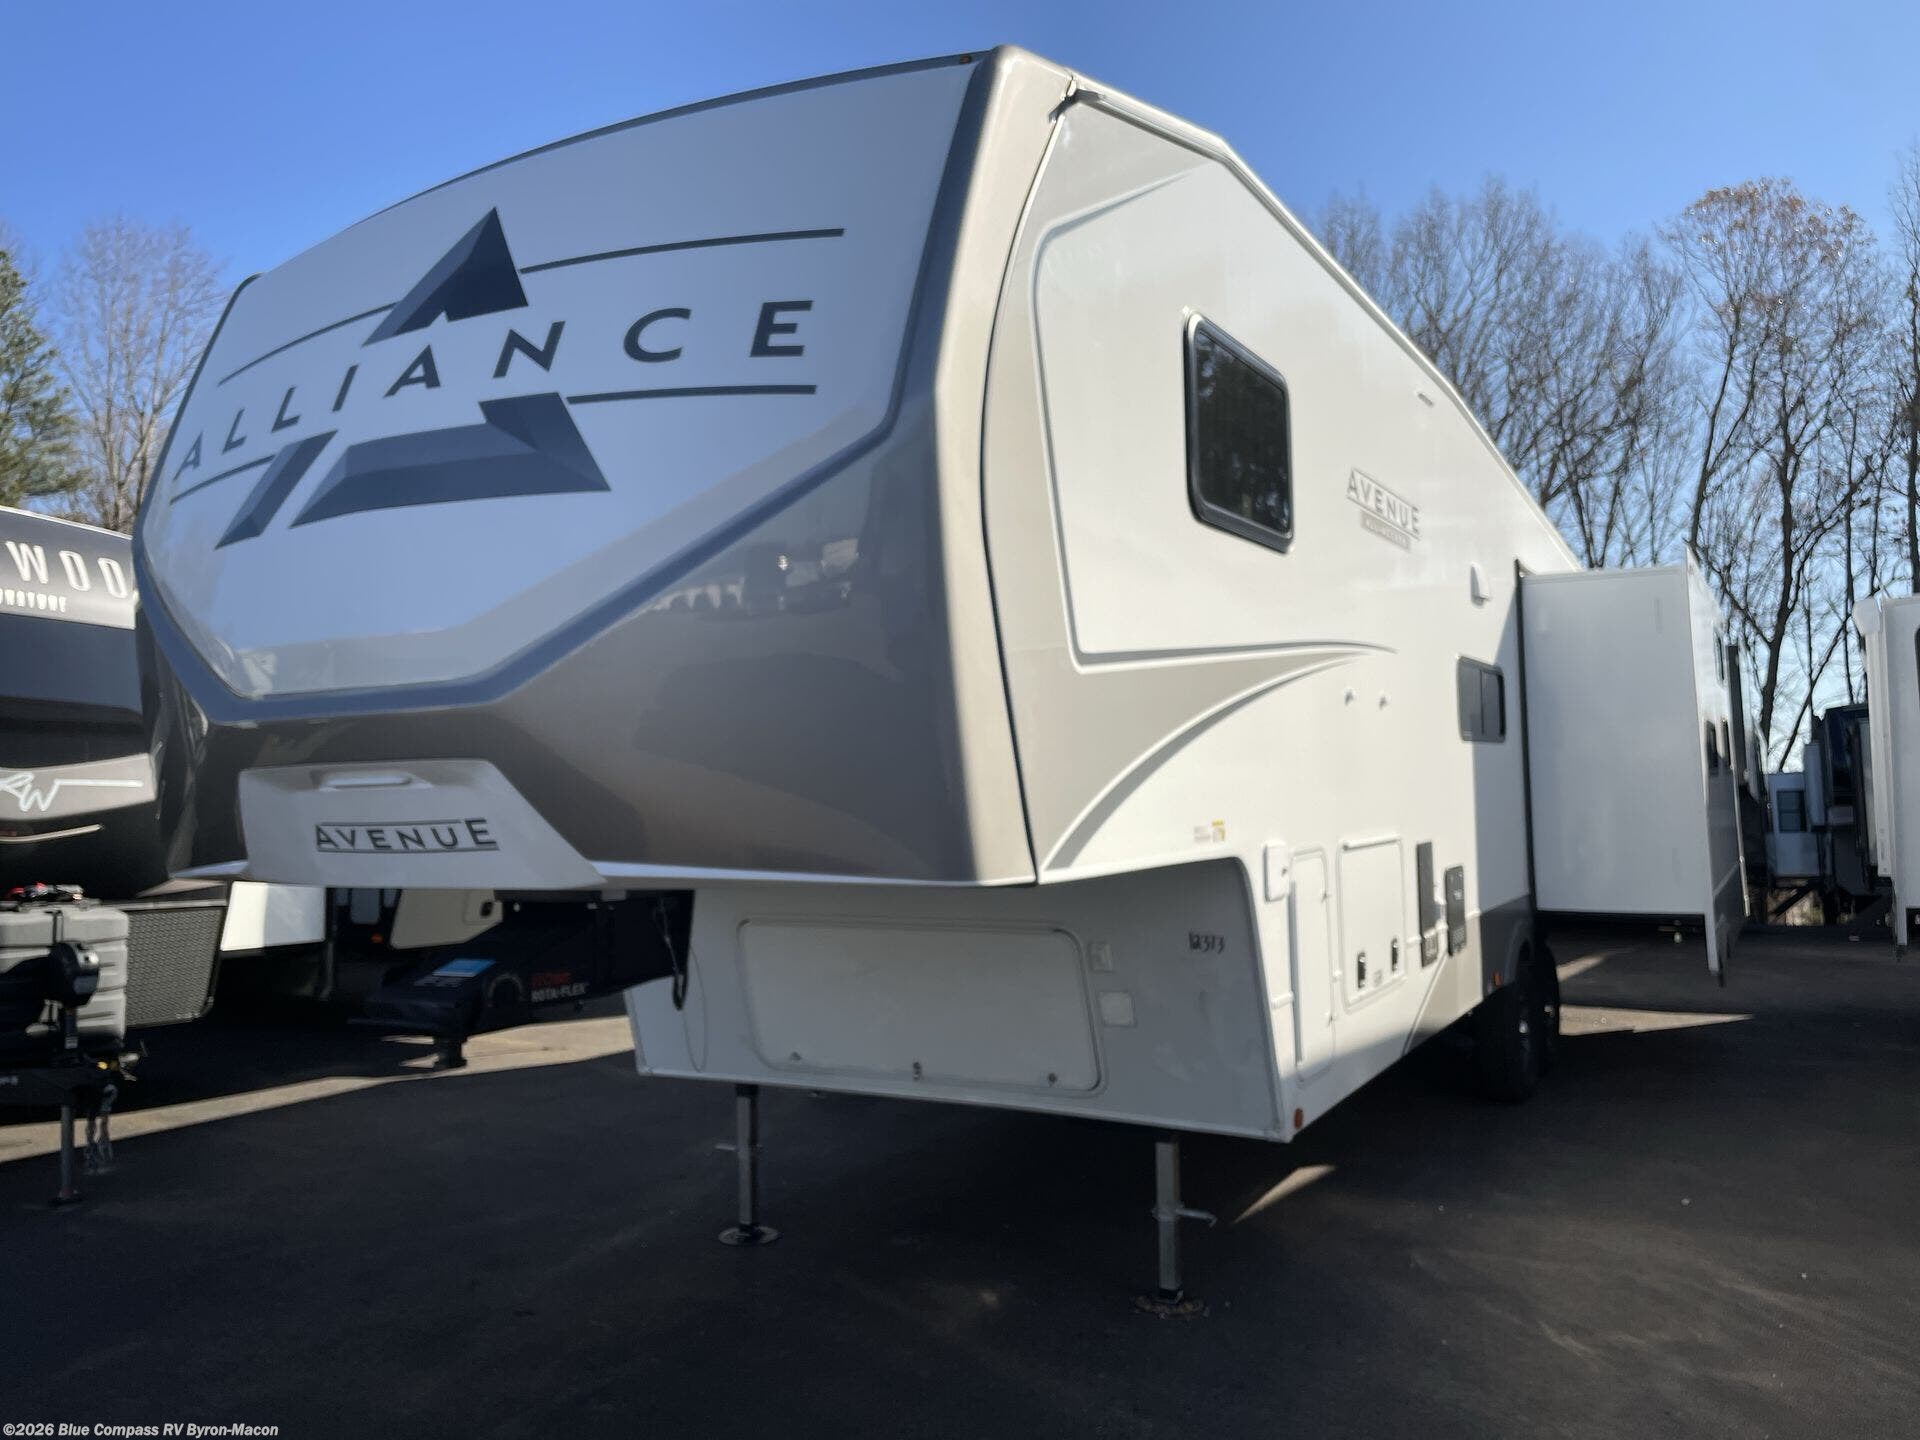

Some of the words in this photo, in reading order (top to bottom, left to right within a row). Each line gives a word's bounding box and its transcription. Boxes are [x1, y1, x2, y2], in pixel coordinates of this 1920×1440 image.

[173, 299, 813, 481] ALLIANCE
[1346, 468, 1420, 534] AVENUE
[315, 817, 497, 850] AVENUE
